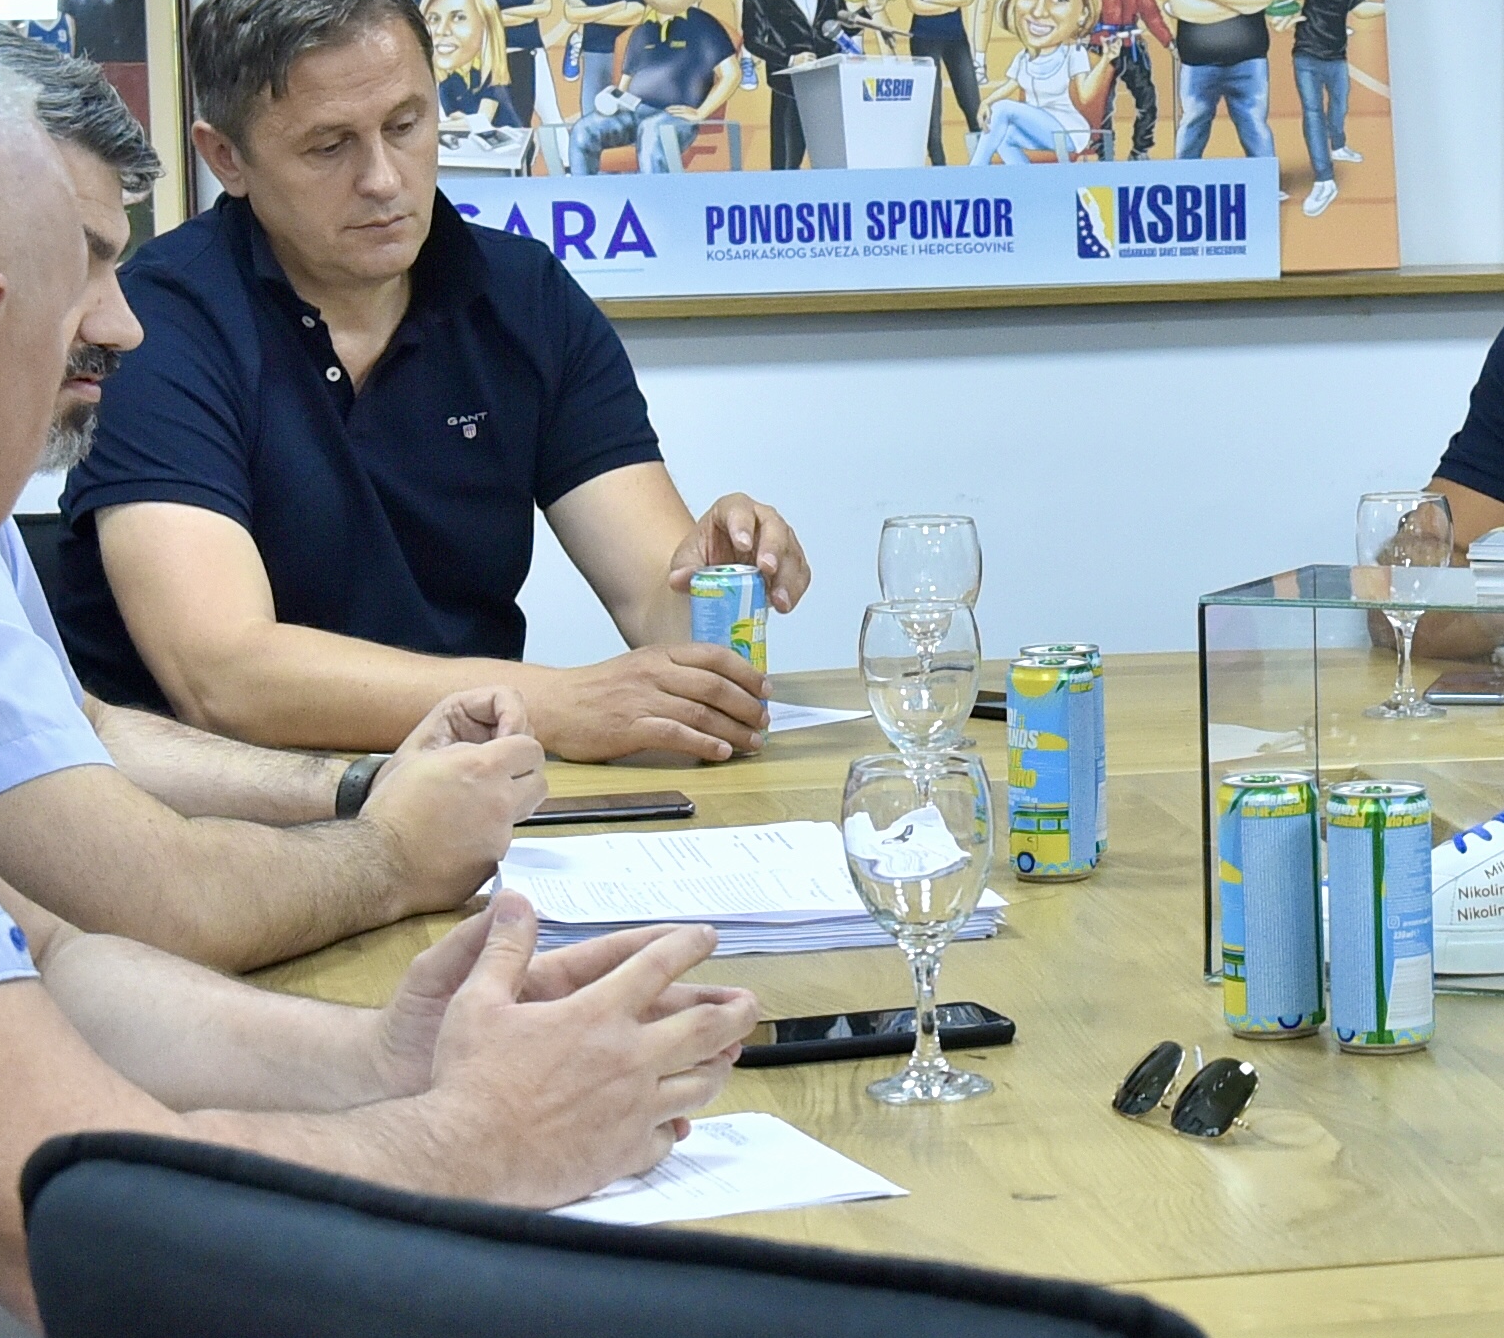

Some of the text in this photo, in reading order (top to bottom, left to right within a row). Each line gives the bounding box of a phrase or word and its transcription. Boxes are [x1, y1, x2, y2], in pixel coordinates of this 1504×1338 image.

[876, 78, 914, 97] KSBIH
[705, 198, 1014, 246] PONOSNI SPONZOR
[1118, 183, 1247, 244] KSBIH
[706, 247, 807, 262] KOŠARKAŠKOG
[810, 245, 860, 258] SAVEZA
[863, 244, 908, 258] BOSNE
[919, 241, 1015, 255] HERCEGOVINE
[447, 411, 488, 426] GANT
